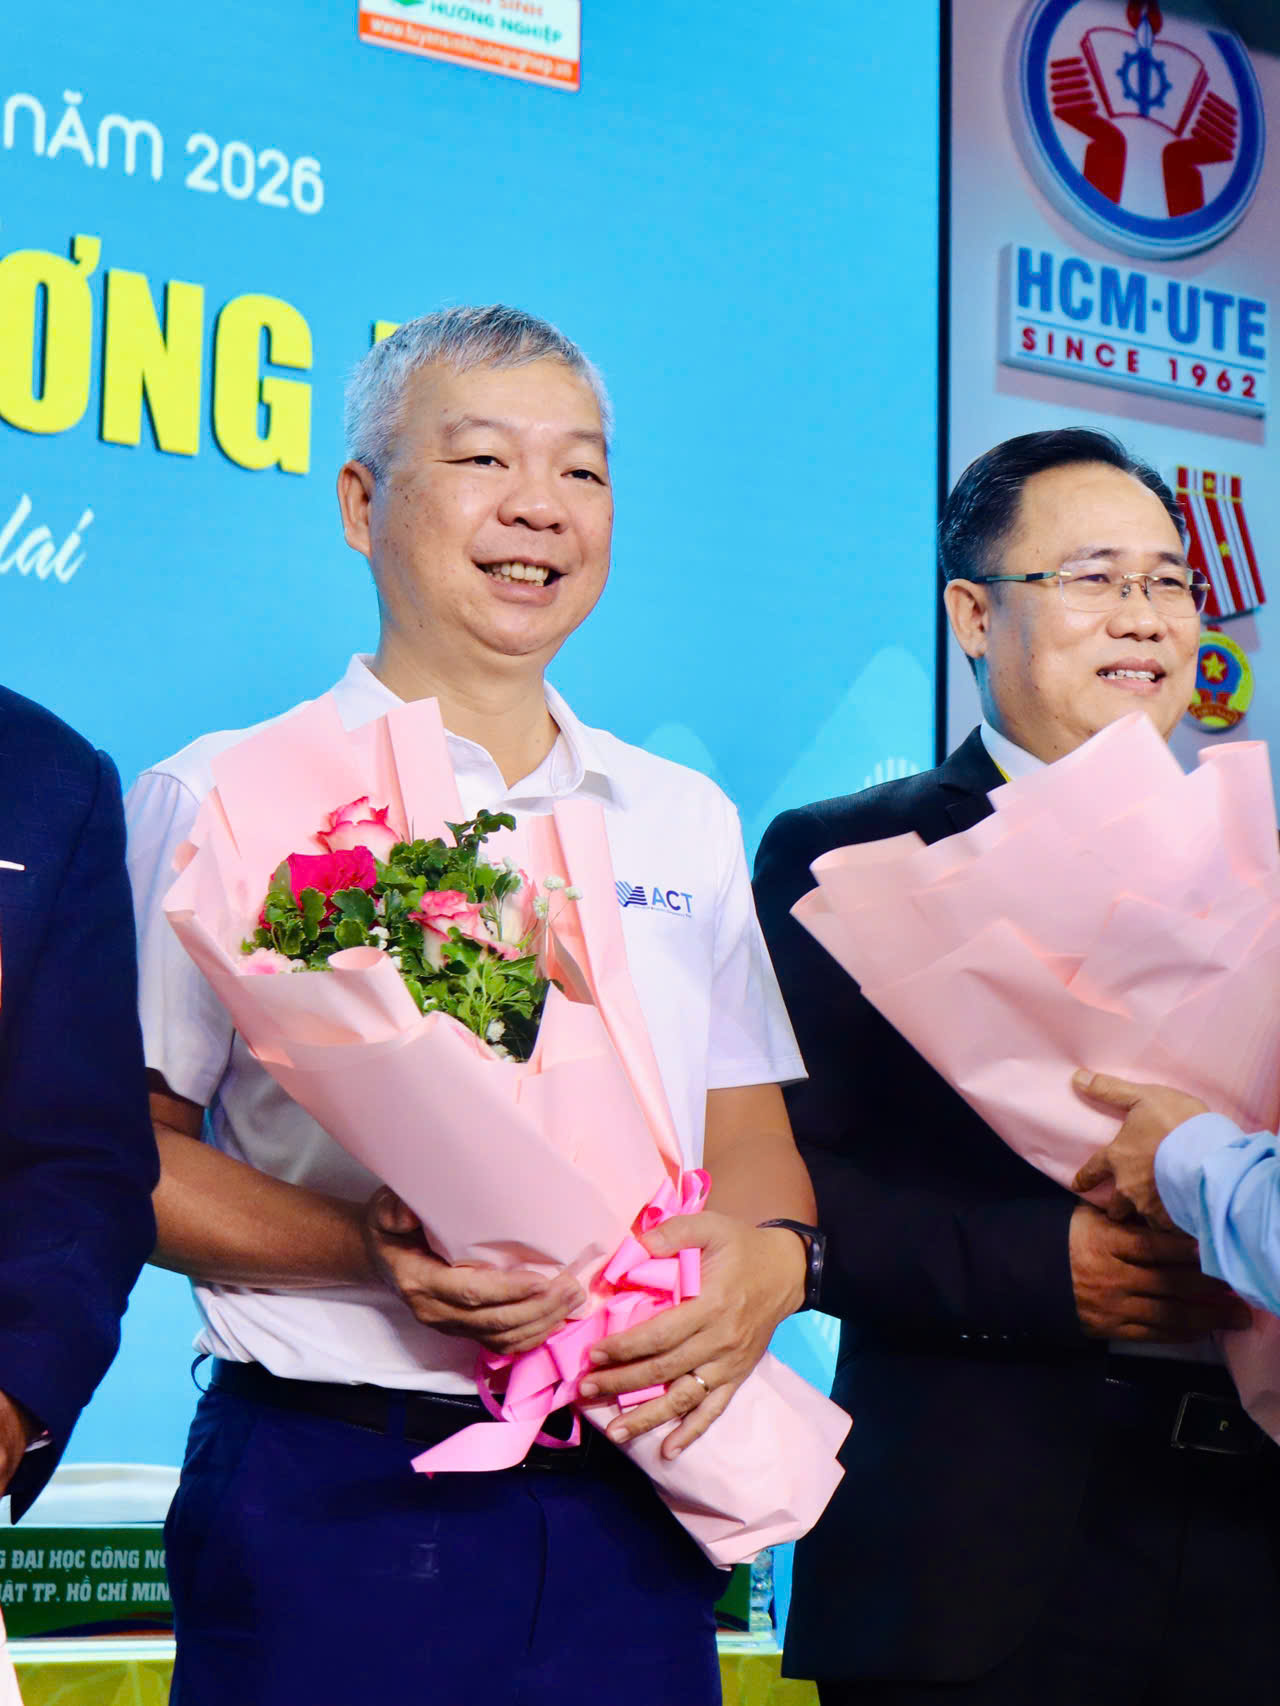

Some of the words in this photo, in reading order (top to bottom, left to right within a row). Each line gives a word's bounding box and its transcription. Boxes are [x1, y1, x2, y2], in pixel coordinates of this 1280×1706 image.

[185, 132, 325, 215] 2026
[1022, 327, 1139, 373] SINCE
[1168, 358, 1257, 399] 1962
[652, 887, 693, 913] ACT
[12, 1549, 45, 1572] ĐẠI
[49, 1549, 86, 1572] HỌC
[90, 1546, 140, 1569] CÔNG
[32, 1582, 61, 1602] TP.
[66, 1576, 92, 1602] HỒ
[97, 1578, 128, 1602] CHÍ
